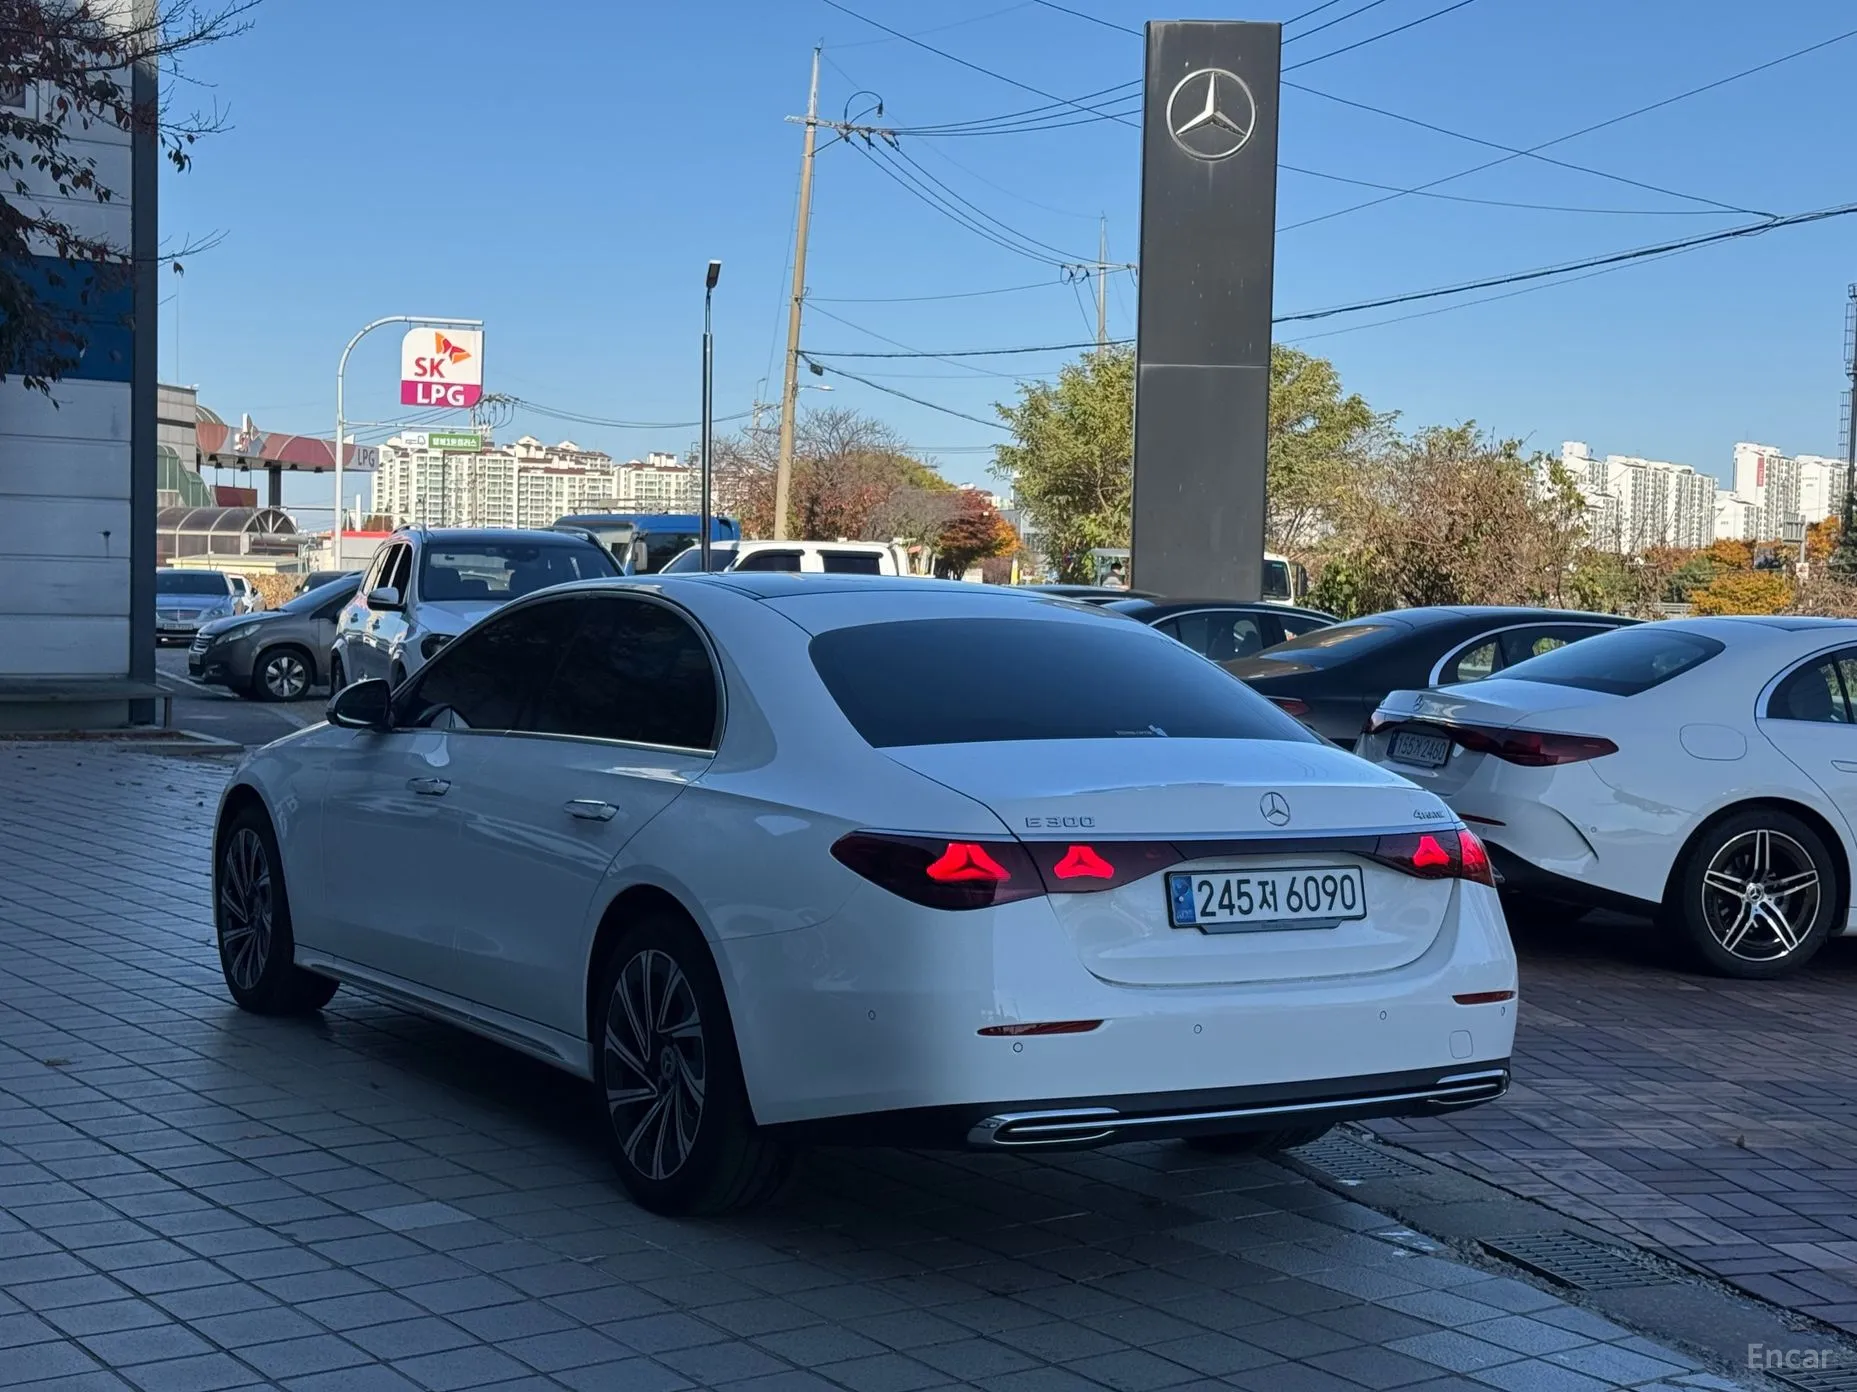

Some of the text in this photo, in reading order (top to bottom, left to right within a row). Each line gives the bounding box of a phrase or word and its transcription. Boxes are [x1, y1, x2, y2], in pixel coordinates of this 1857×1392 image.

[414, 356, 446, 379] SK
[416, 382, 465, 406] LPG
[357, 449, 375, 468] LPG
